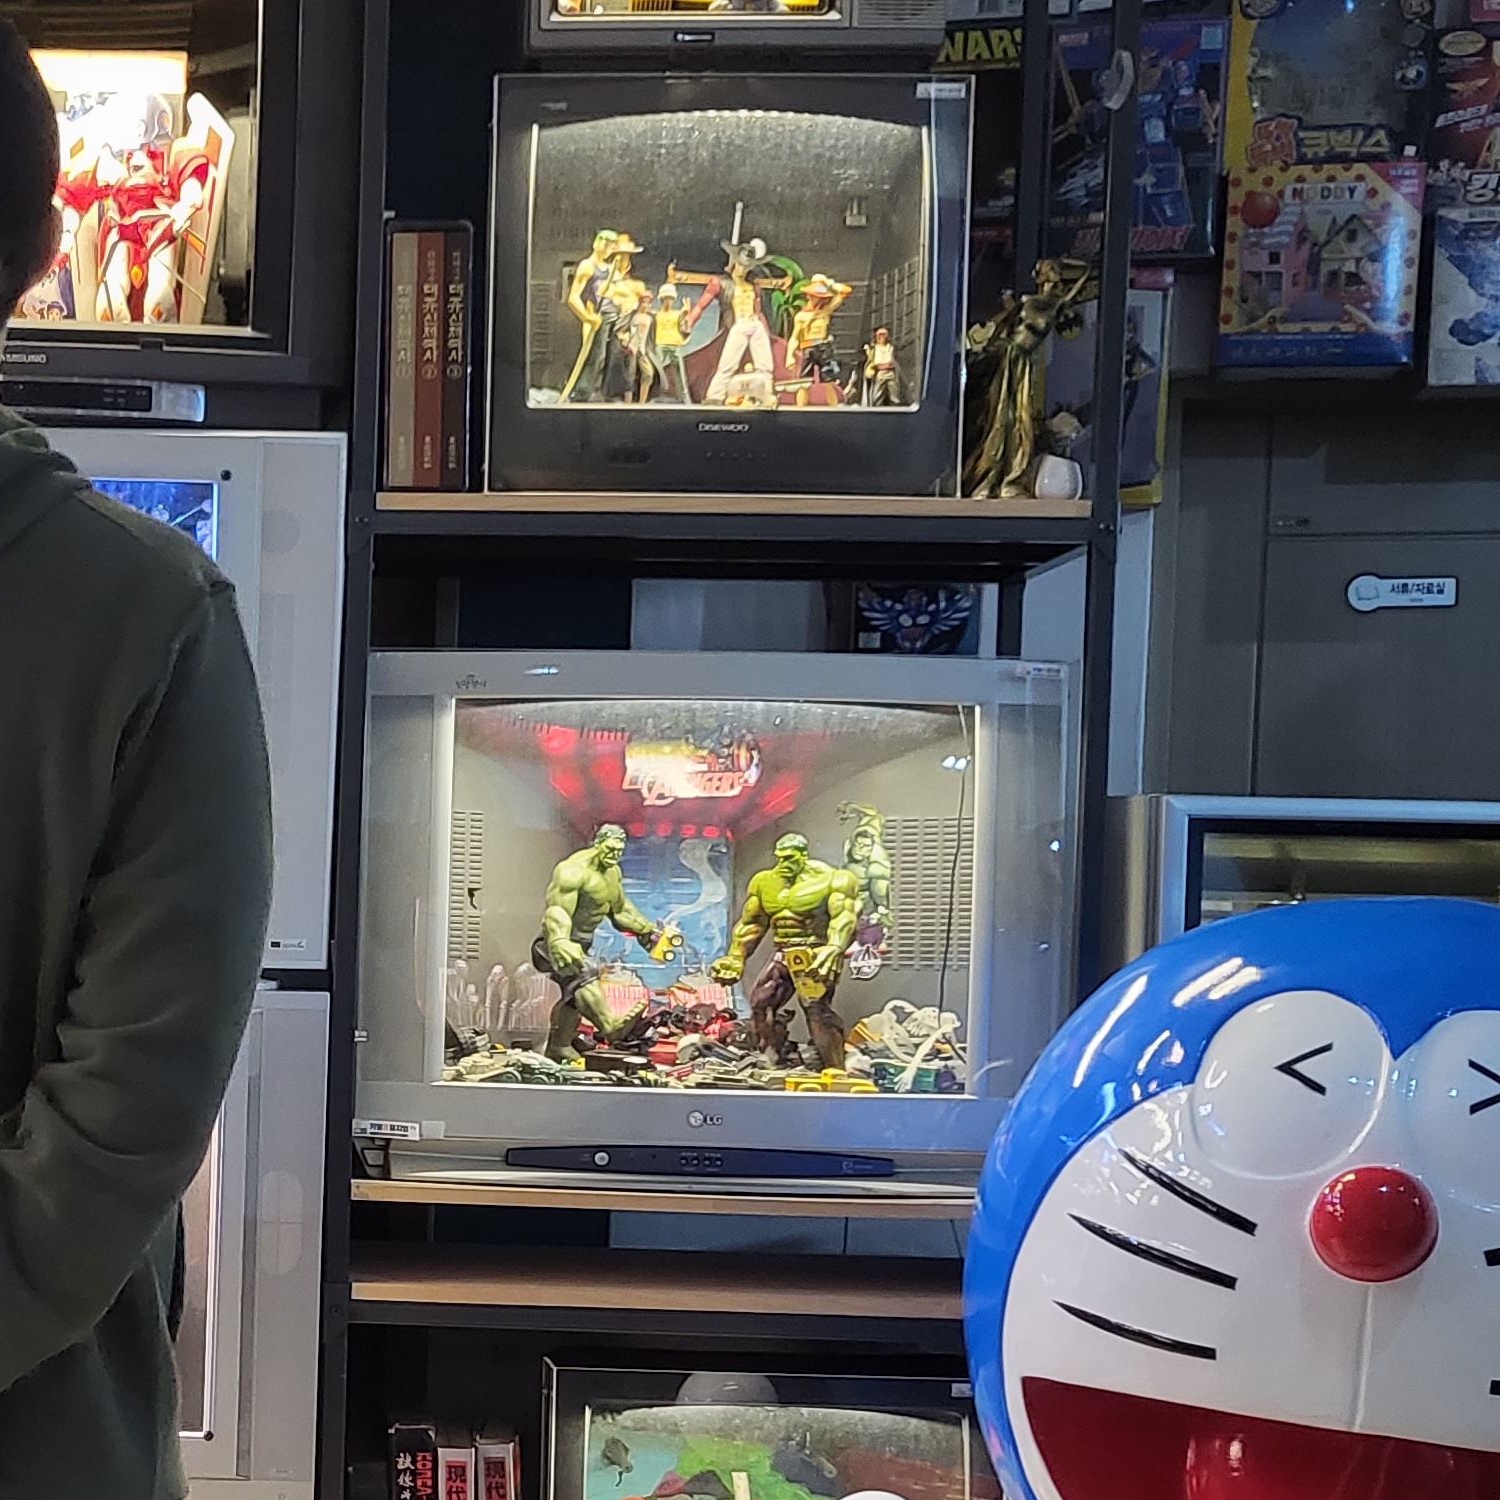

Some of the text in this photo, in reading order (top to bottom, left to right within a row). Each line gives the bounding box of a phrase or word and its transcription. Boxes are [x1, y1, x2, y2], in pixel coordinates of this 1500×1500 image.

[0, 353, 47, 364] MSUNG
[698, 422, 750, 432] DAEWOO
[1389, 581, 1446, 595] 서류/자료실
